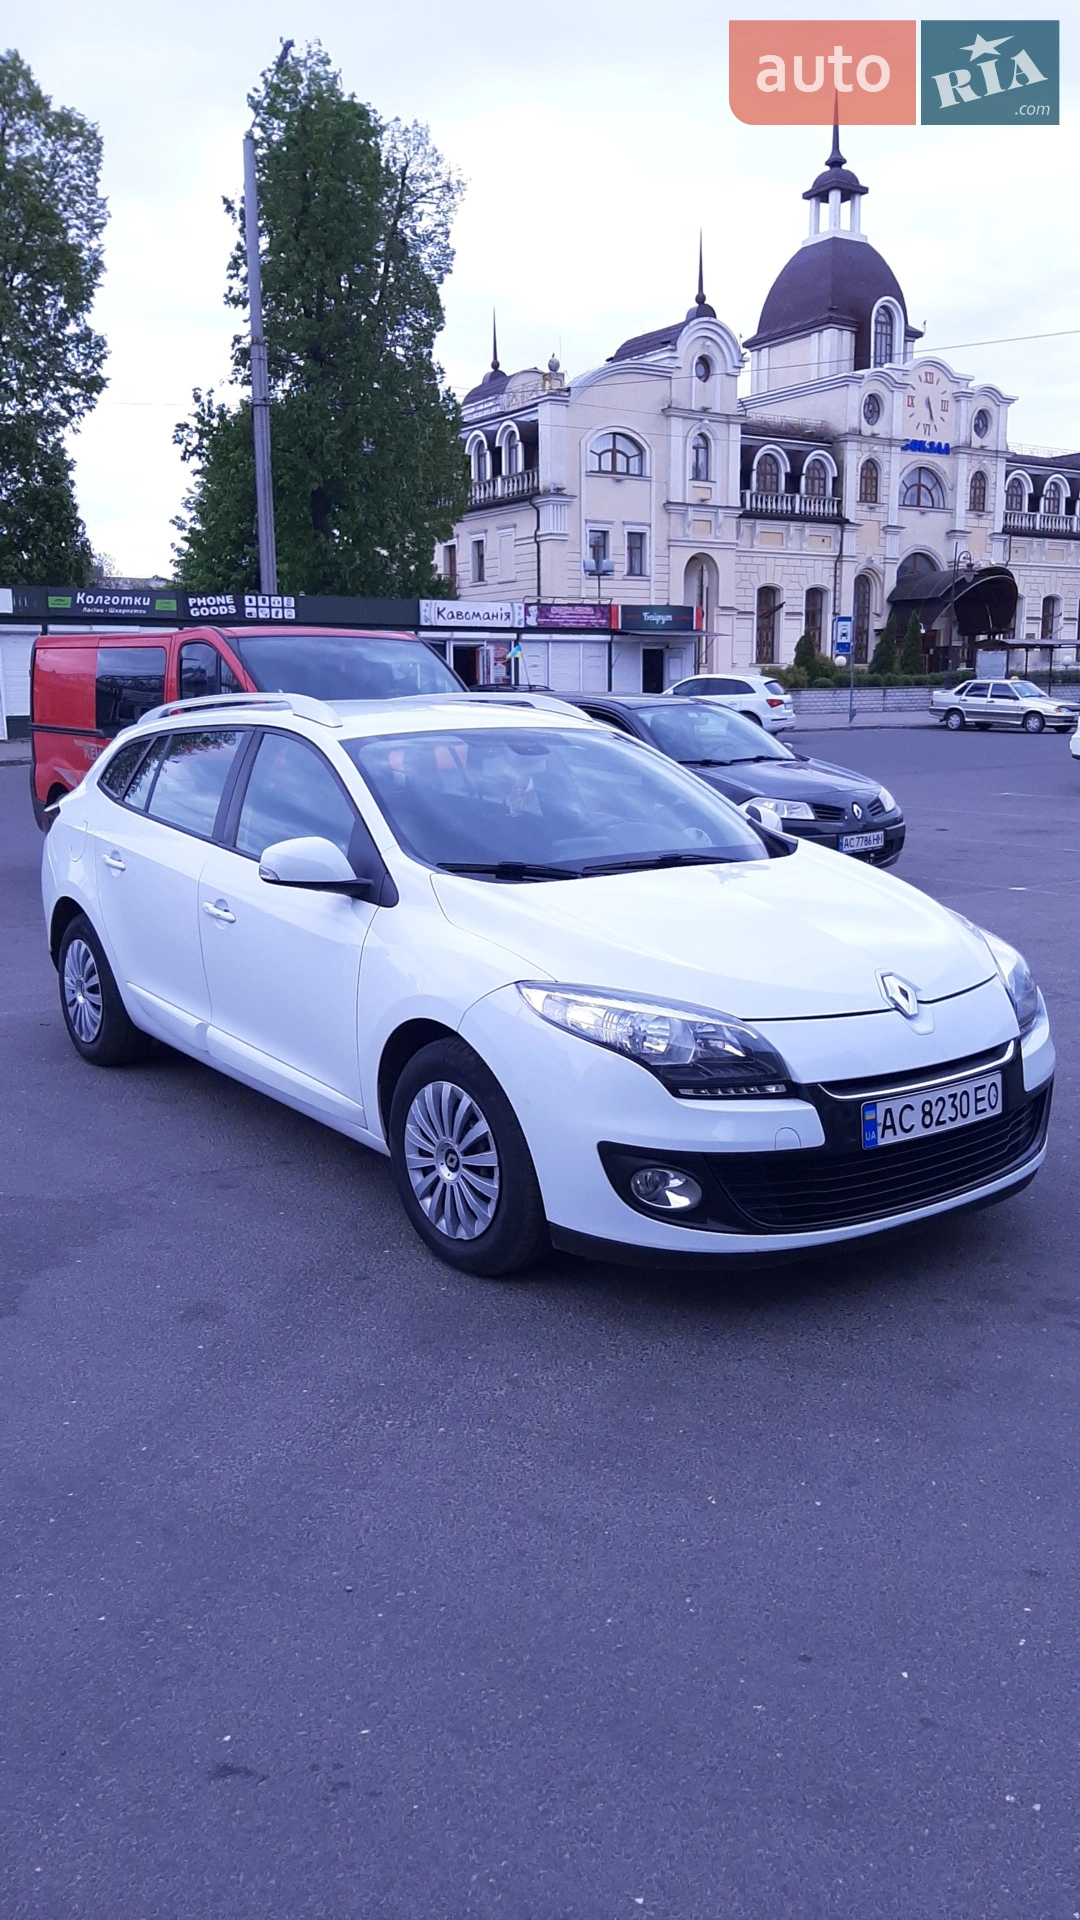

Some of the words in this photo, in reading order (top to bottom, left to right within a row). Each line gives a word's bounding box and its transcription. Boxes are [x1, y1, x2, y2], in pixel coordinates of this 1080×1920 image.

[76, 592, 151, 606] Колготки
[188, 595, 235, 607] PHONE
[190, 605, 237, 617] GOODS
[436, 606, 511, 622] Кавоманія
[880, 1103, 915, 1139] AC
[921, 1089, 970, 1129] 8230
[865, 1131, 877, 1141] UA
